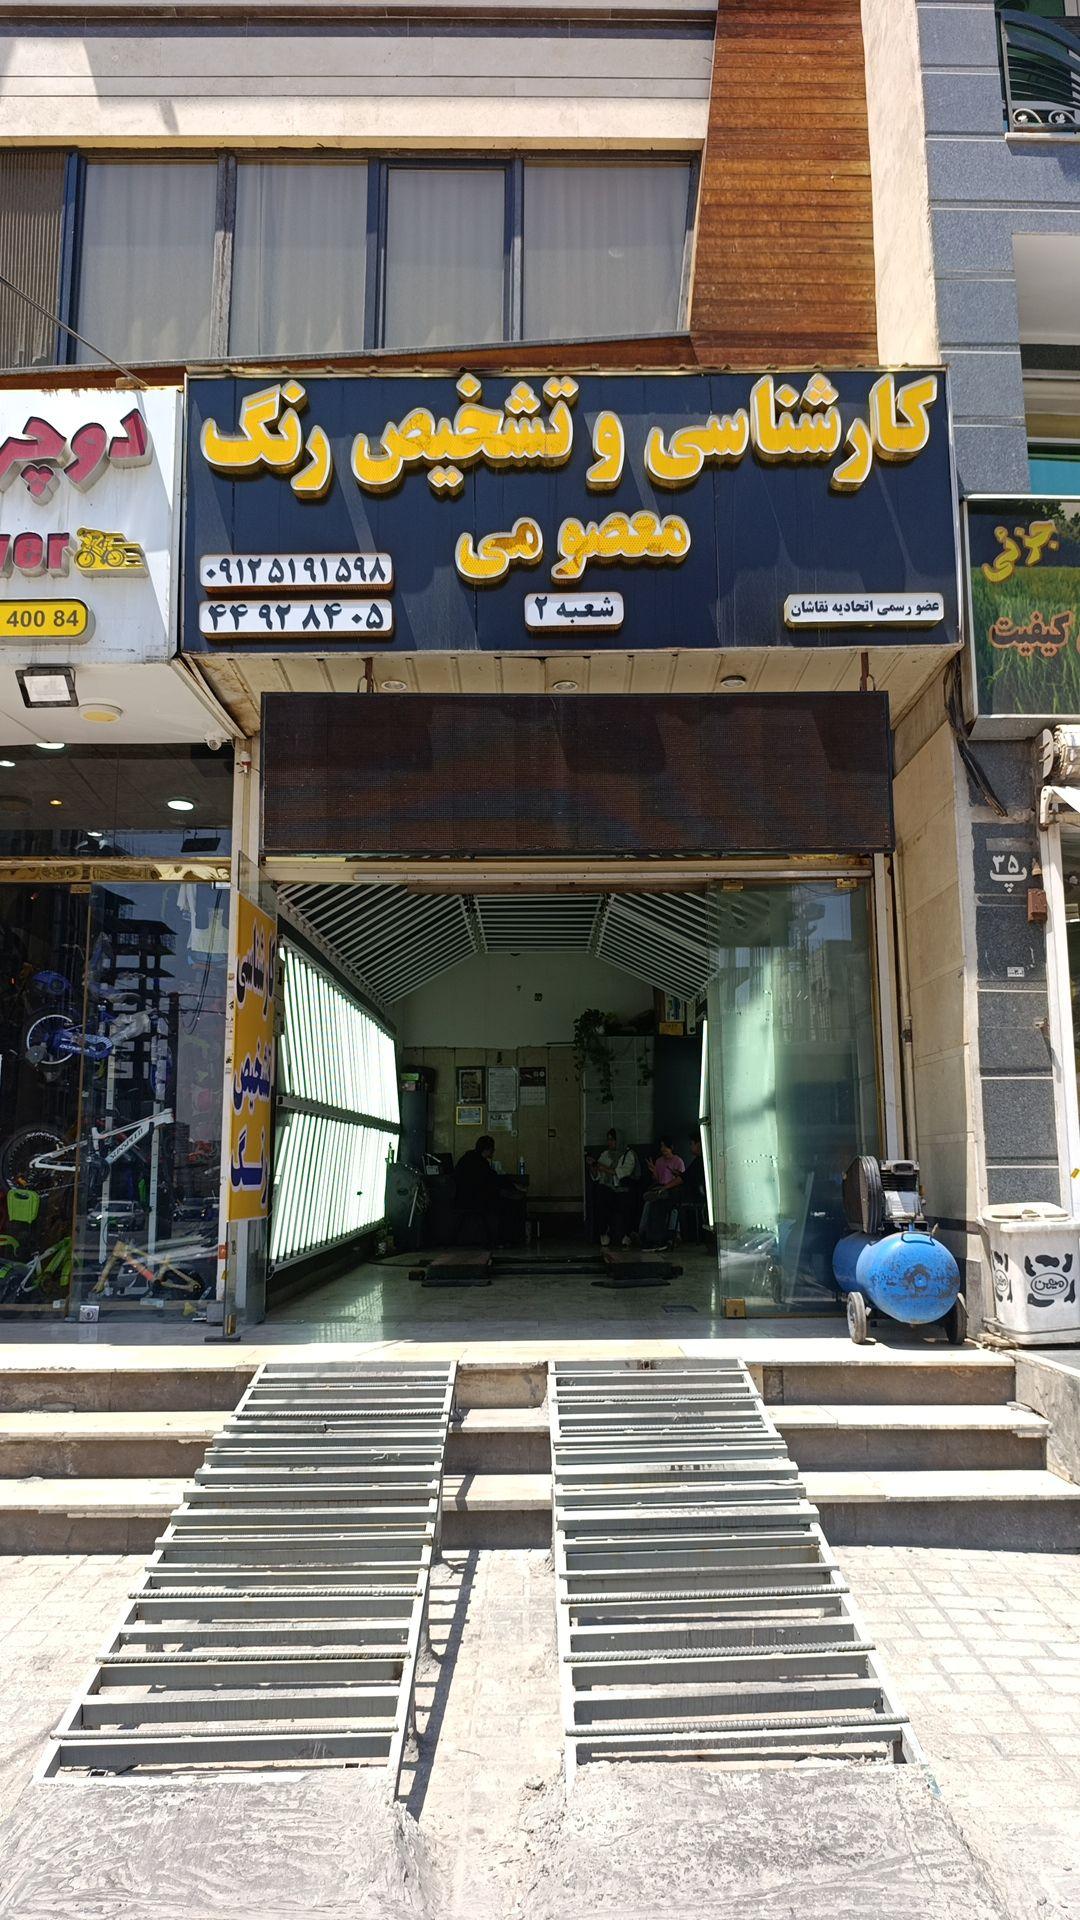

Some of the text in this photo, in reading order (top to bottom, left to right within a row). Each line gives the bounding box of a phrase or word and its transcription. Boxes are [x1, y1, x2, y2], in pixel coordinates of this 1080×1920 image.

[201, 372, 938, 494] کارشناسی و تشخیص رنگ
[6, 609, 79, 628] 400 84
[535, 596, 614, 624] شعبه ۲
[791, 599, 940, 617] عضو رسمی اتحادیه نقاشان
[989, 611, 1073, 657] کیفیت
[236, 923, 276, 1020] کارشناسی
[232, 1038, 272, 1114] تشخیص
[230, 1126, 269, 1209] رنگ
